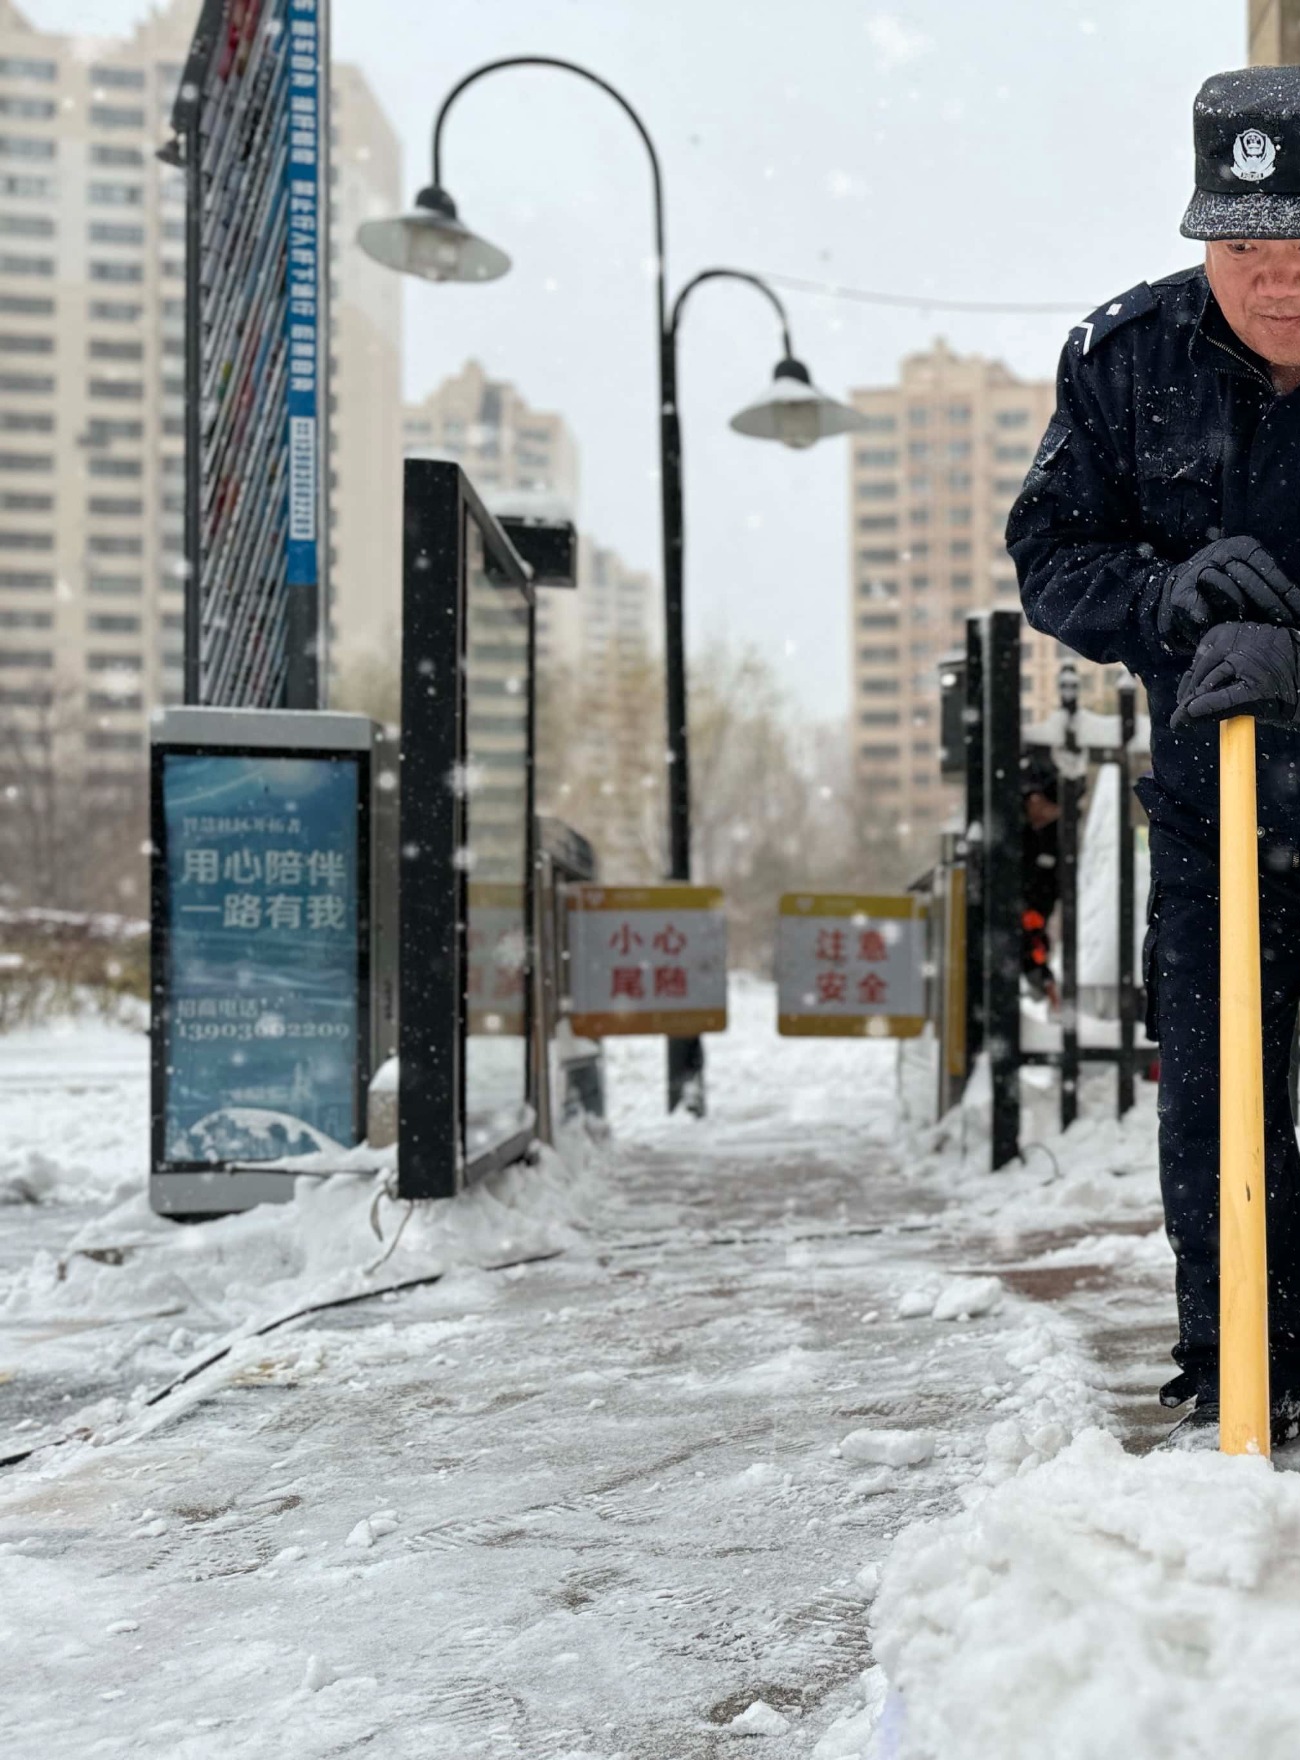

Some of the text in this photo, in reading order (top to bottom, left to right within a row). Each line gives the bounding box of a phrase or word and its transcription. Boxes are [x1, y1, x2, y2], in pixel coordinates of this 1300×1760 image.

[181, 849, 347, 886] 用心陪伴
[180, 893, 347, 931] 一路有我
[610, 923, 687, 956] 小心
[817, 928, 888, 963] 注意
[609, 966, 688, 1000] 尾随
[817, 972, 887, 1004] 安全
